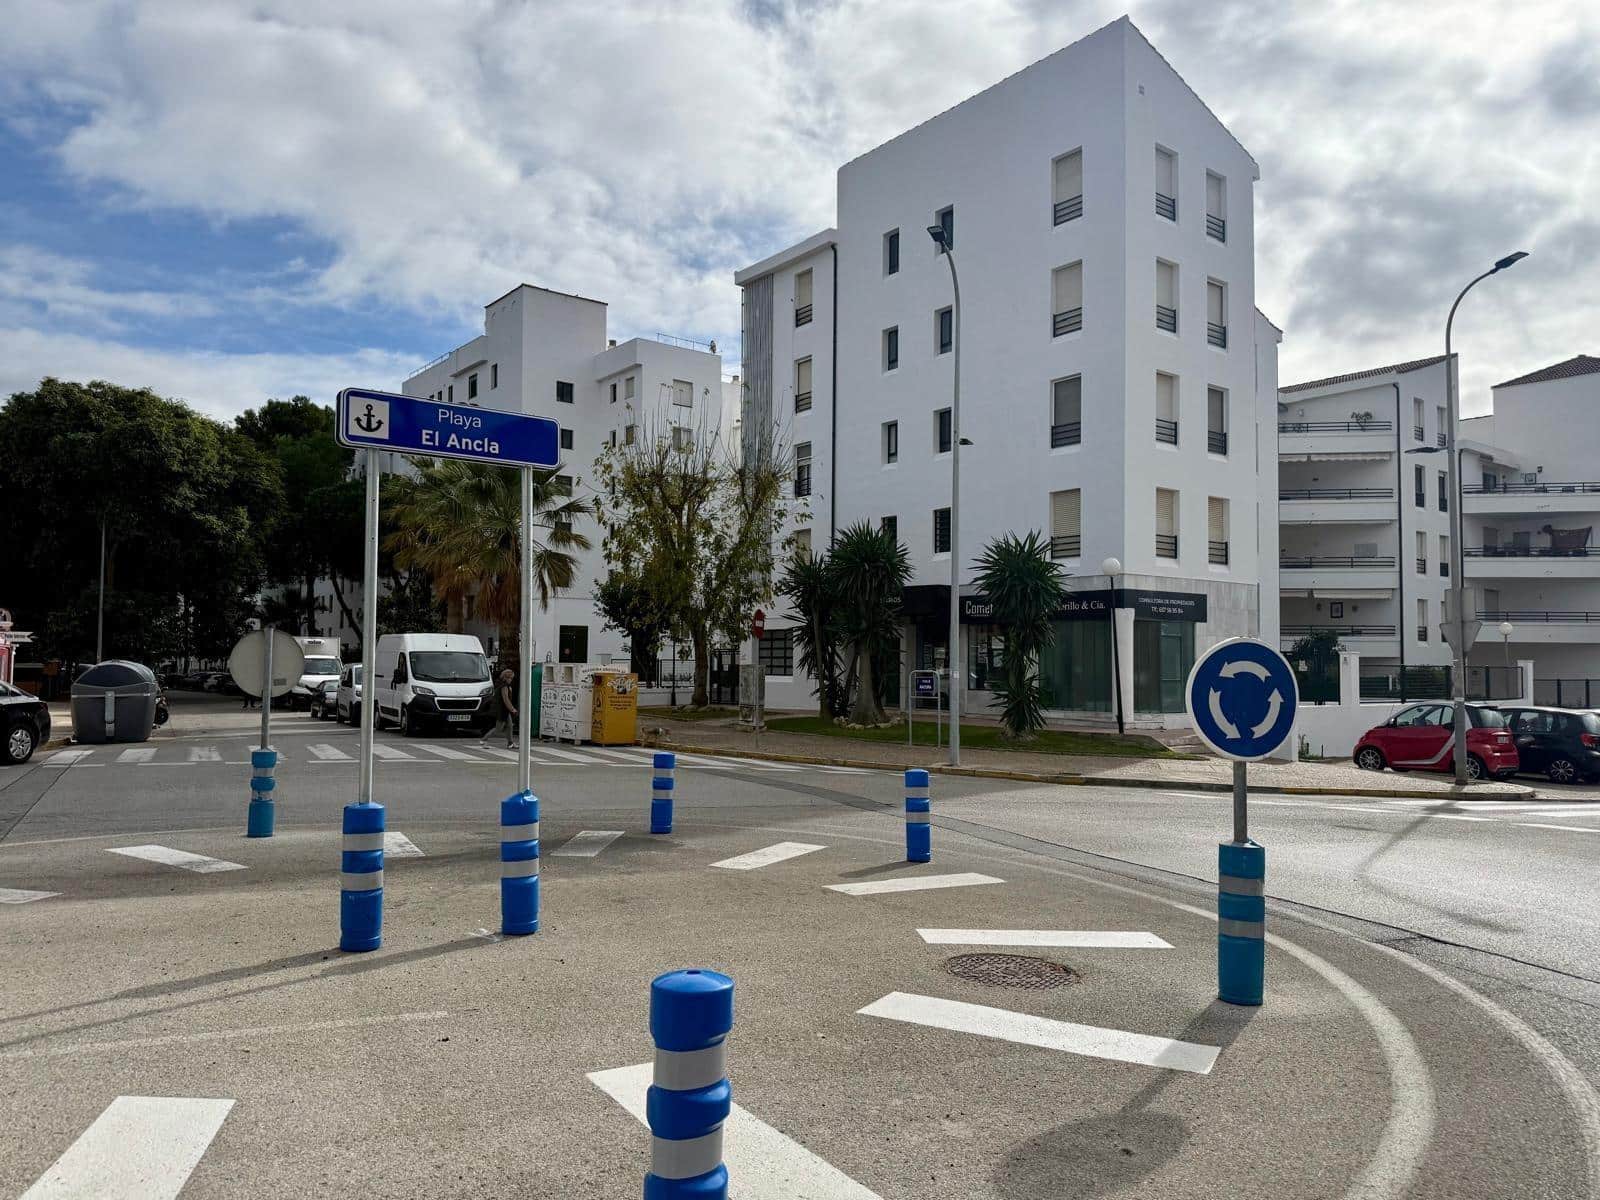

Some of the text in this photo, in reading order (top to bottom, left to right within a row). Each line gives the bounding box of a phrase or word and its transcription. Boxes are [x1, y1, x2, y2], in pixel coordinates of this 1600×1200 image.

[438, 409, 481, 430] Playa
[421, 429, 500, 454] El Ancla
[1081, 601, 1089, 610] &
